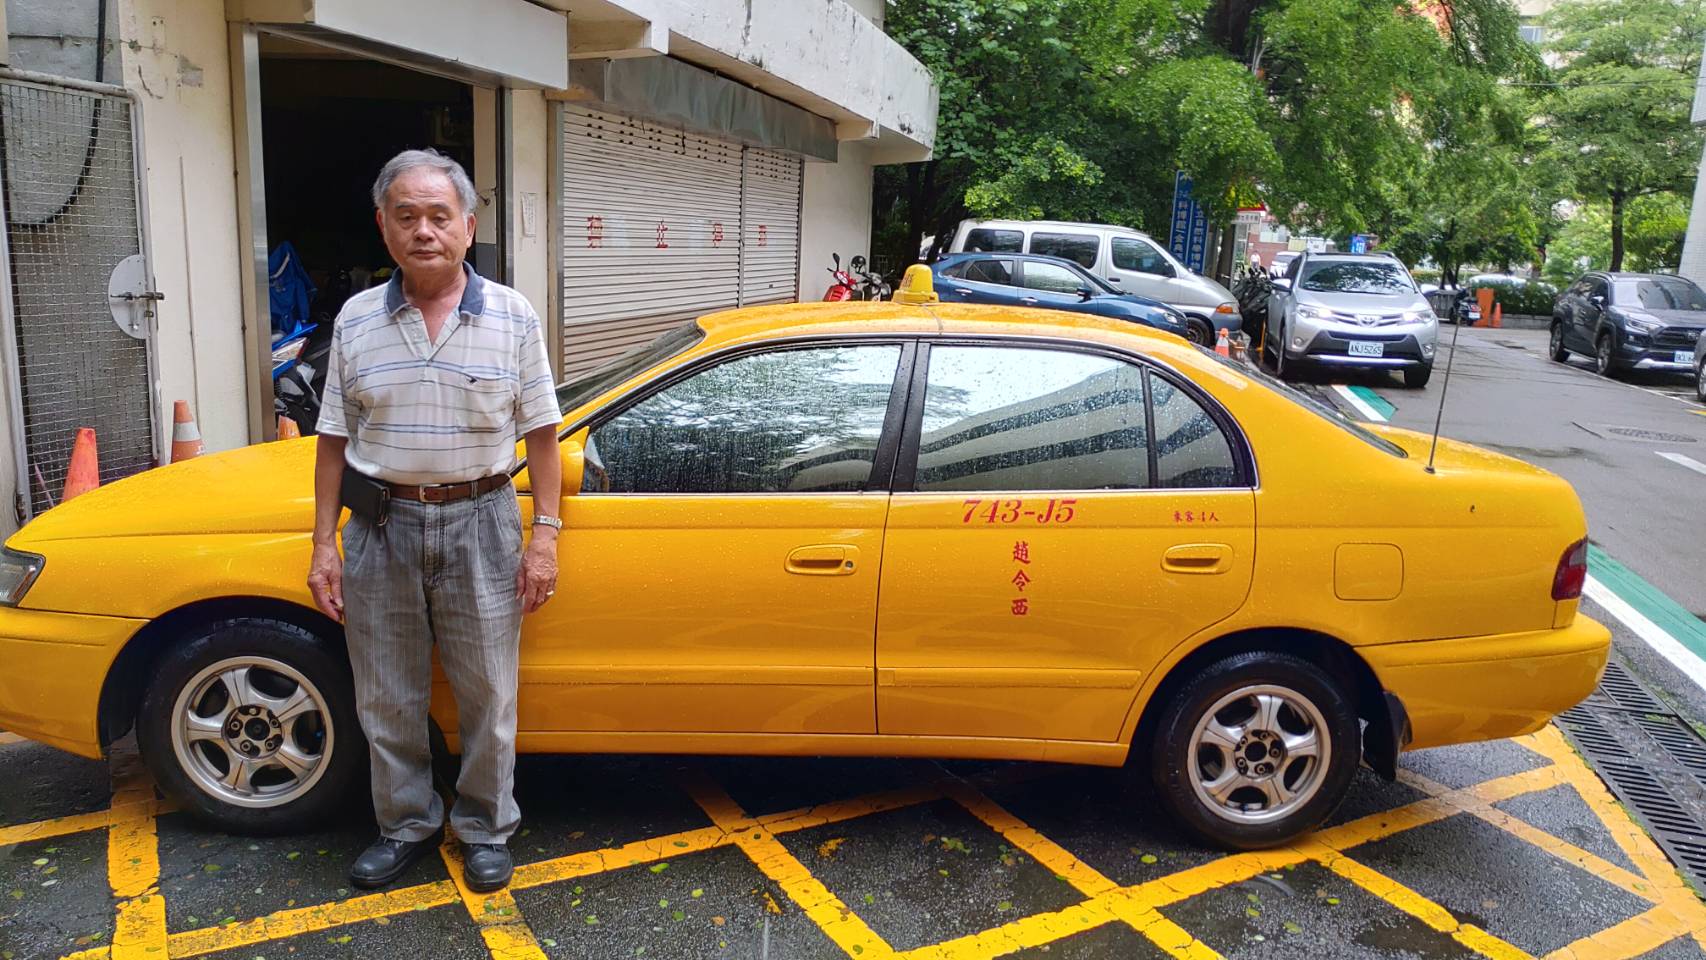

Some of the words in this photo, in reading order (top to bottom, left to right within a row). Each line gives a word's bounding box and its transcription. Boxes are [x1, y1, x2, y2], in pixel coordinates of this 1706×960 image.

[962, 499, 1077, 524] 743-J5
[1011, 540, 1031, 616] 趙令西
